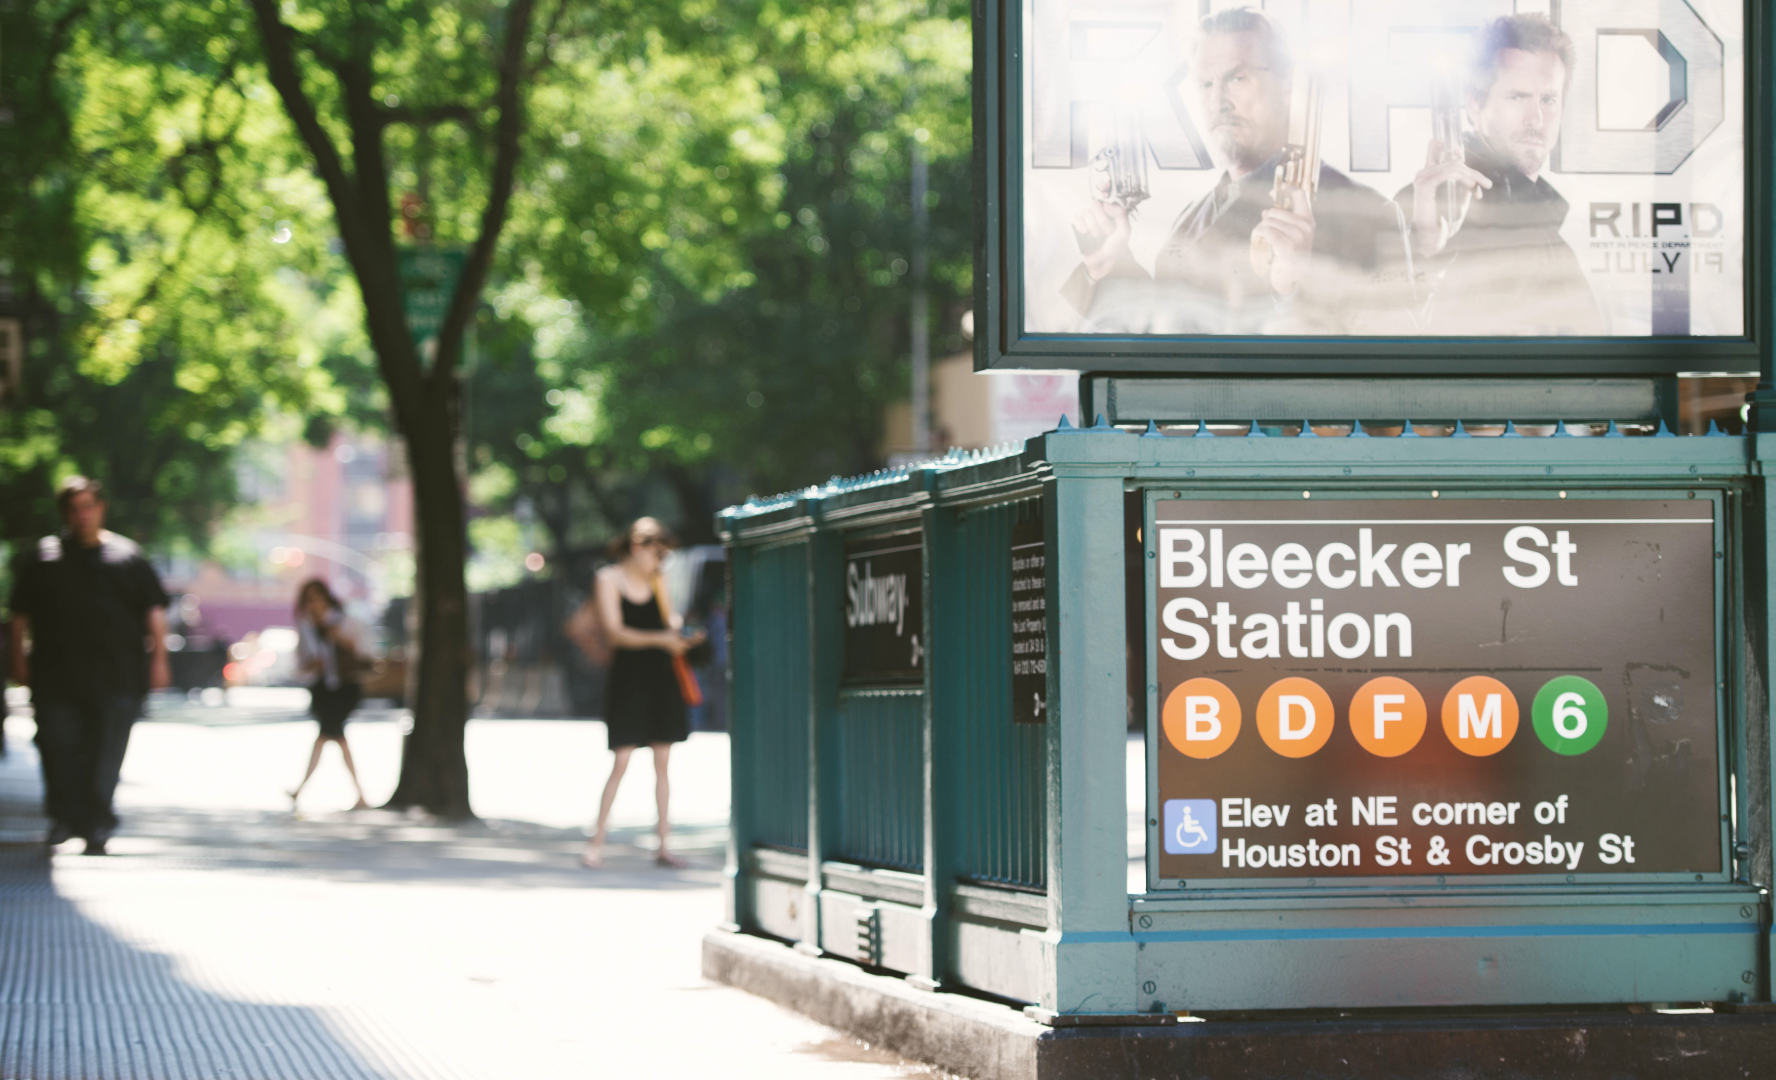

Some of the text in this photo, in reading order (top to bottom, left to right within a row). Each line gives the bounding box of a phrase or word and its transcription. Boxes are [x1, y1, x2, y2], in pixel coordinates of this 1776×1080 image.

[1590, 252, 1681, 274] JULY
[1159, 525, 1578, 590] Bleecker St
[846, 560, 907, 637] Subway
[1160, 597, 1413, 661] Station
[1186, 691, 1588, 741] B D F M 6
[1221, 794, 1569, 828] Elev at NE corner of
[1221, 833, 1635, 870] Houston St & Crosby St
